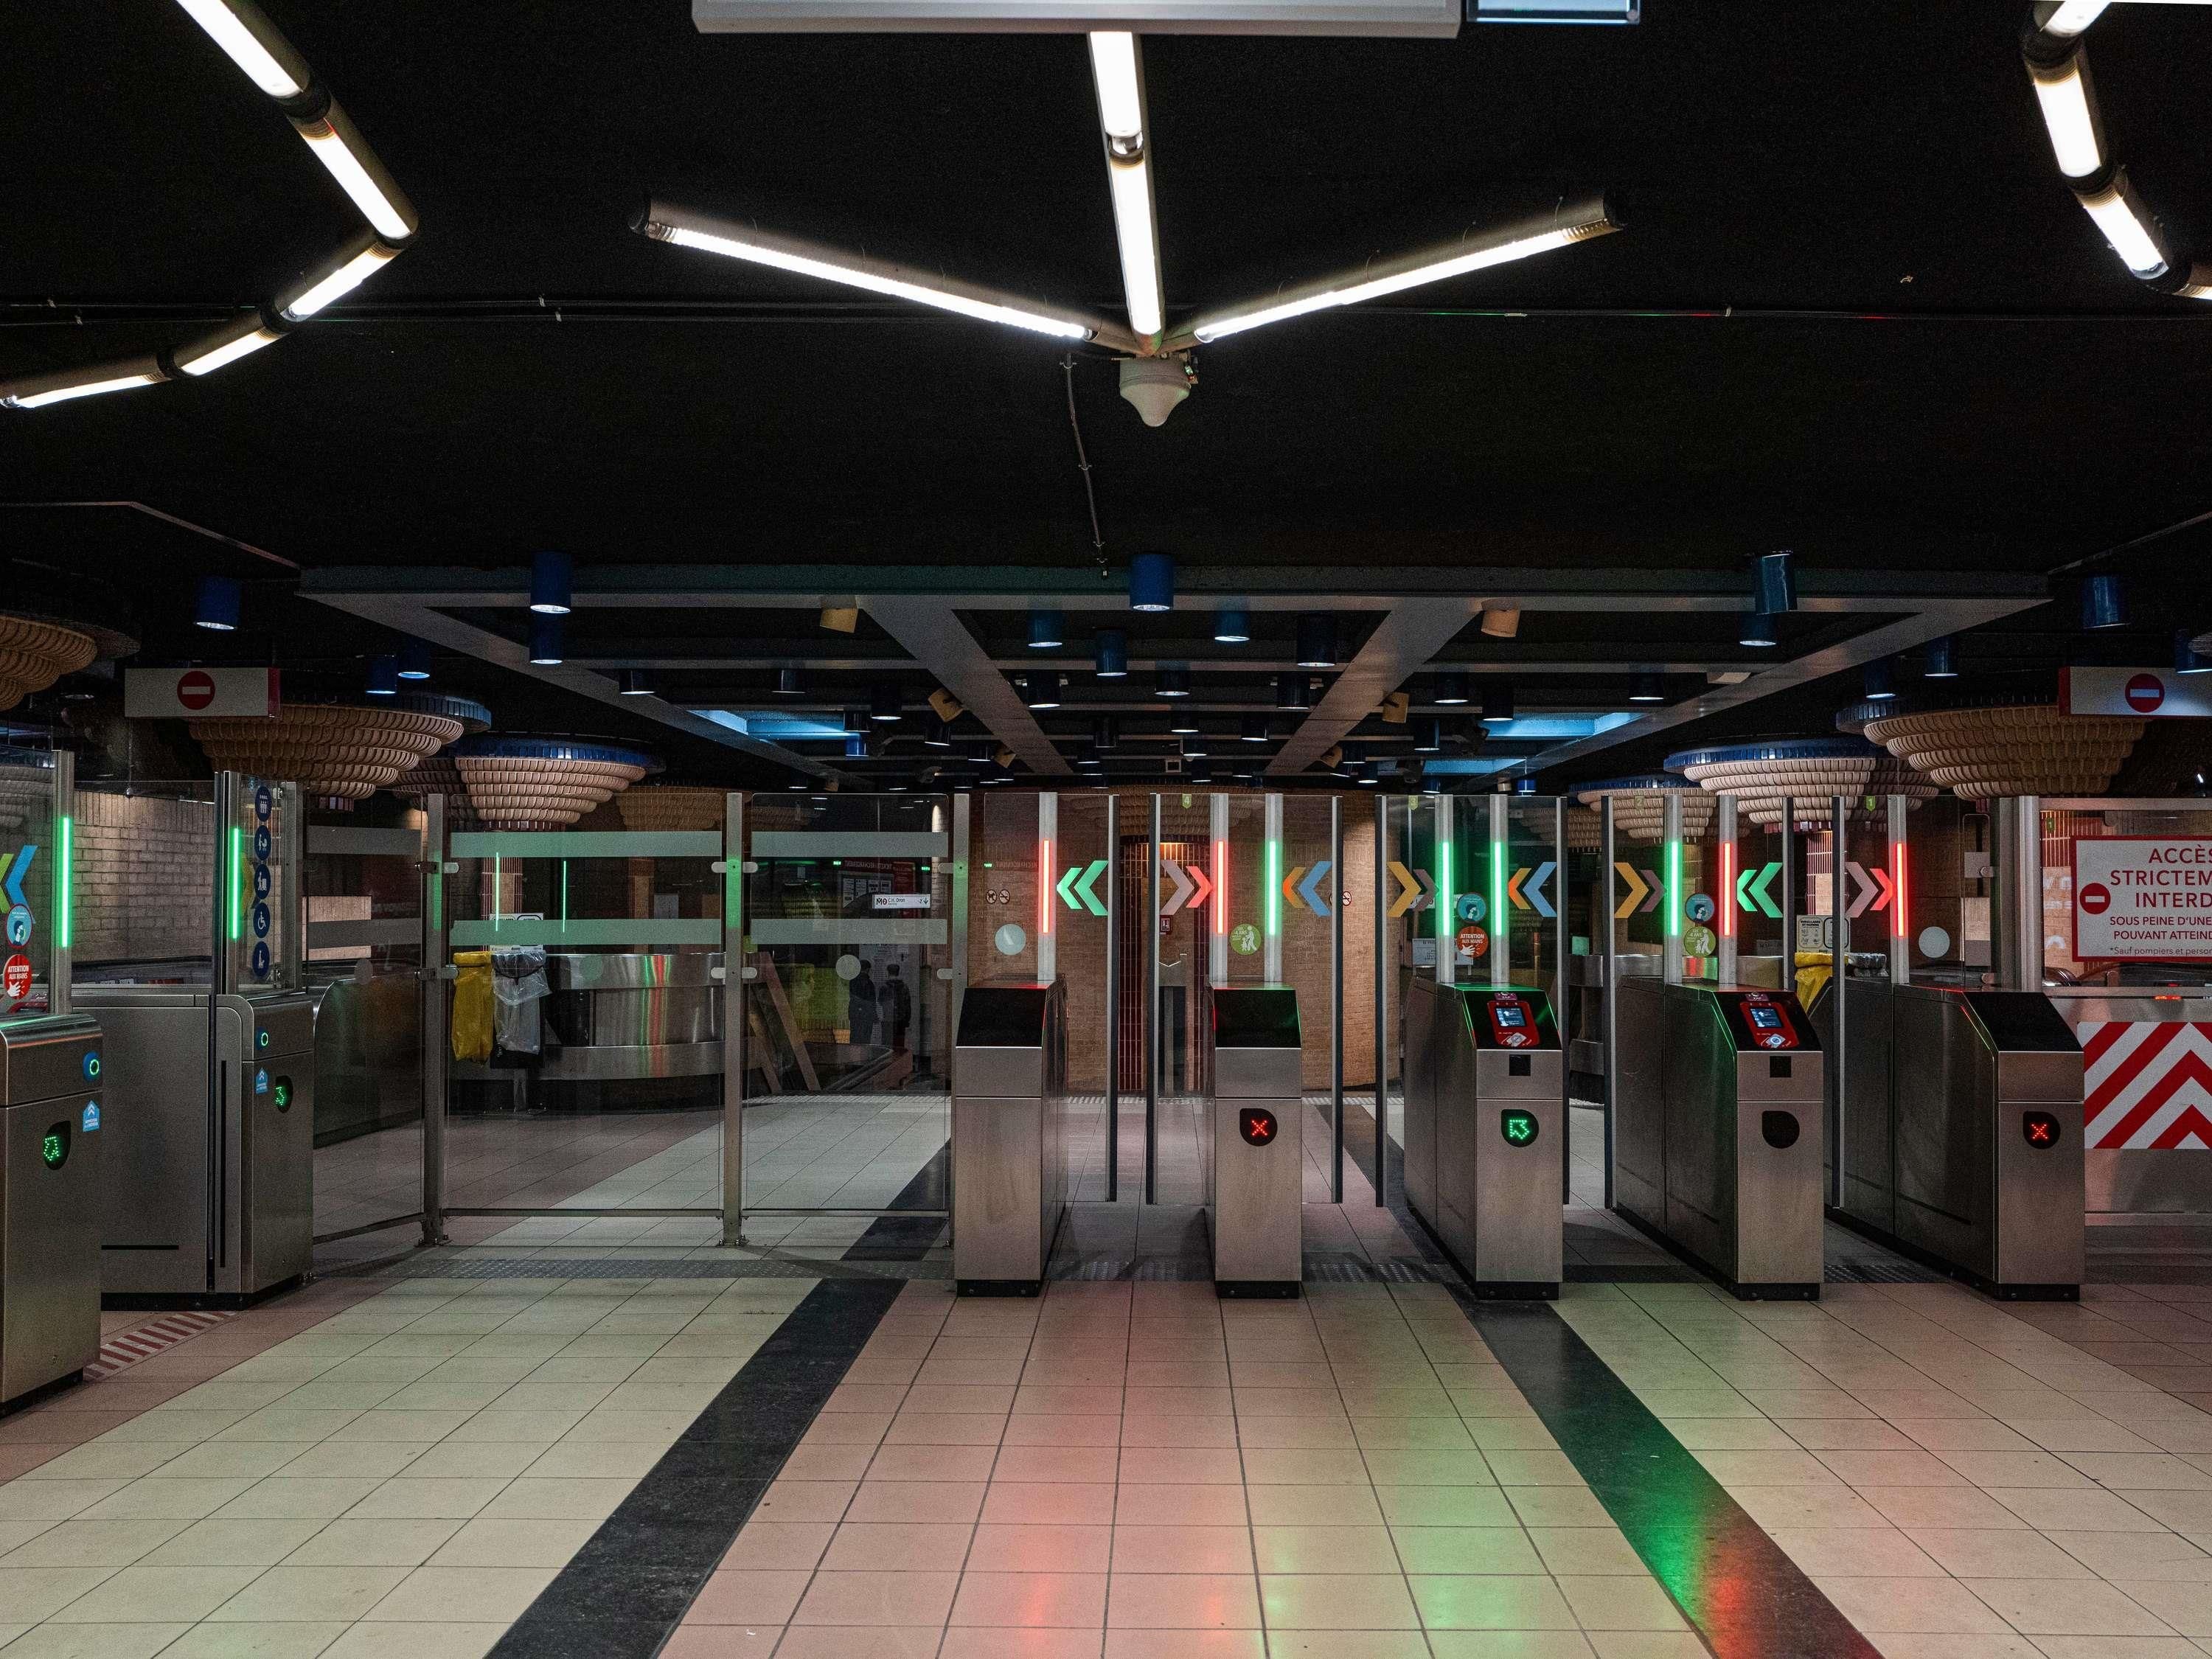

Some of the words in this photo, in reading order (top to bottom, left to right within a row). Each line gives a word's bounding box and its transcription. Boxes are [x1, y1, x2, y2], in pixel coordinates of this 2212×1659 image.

[1184, 796, 1190, 804] 4
[2110, 870, 2212, 886] STRICTEM
[2135, 892, 2212, 908] INTERD
[2110, 917, 2139, 925] SOUS
[2143, 917, 2174, 925] PEINE
[2177, 917, 2212, 925] D'UNE
[2114, 931, 2167, 940] POUVANT
[2134, 947, 2174, 956] pompiers
